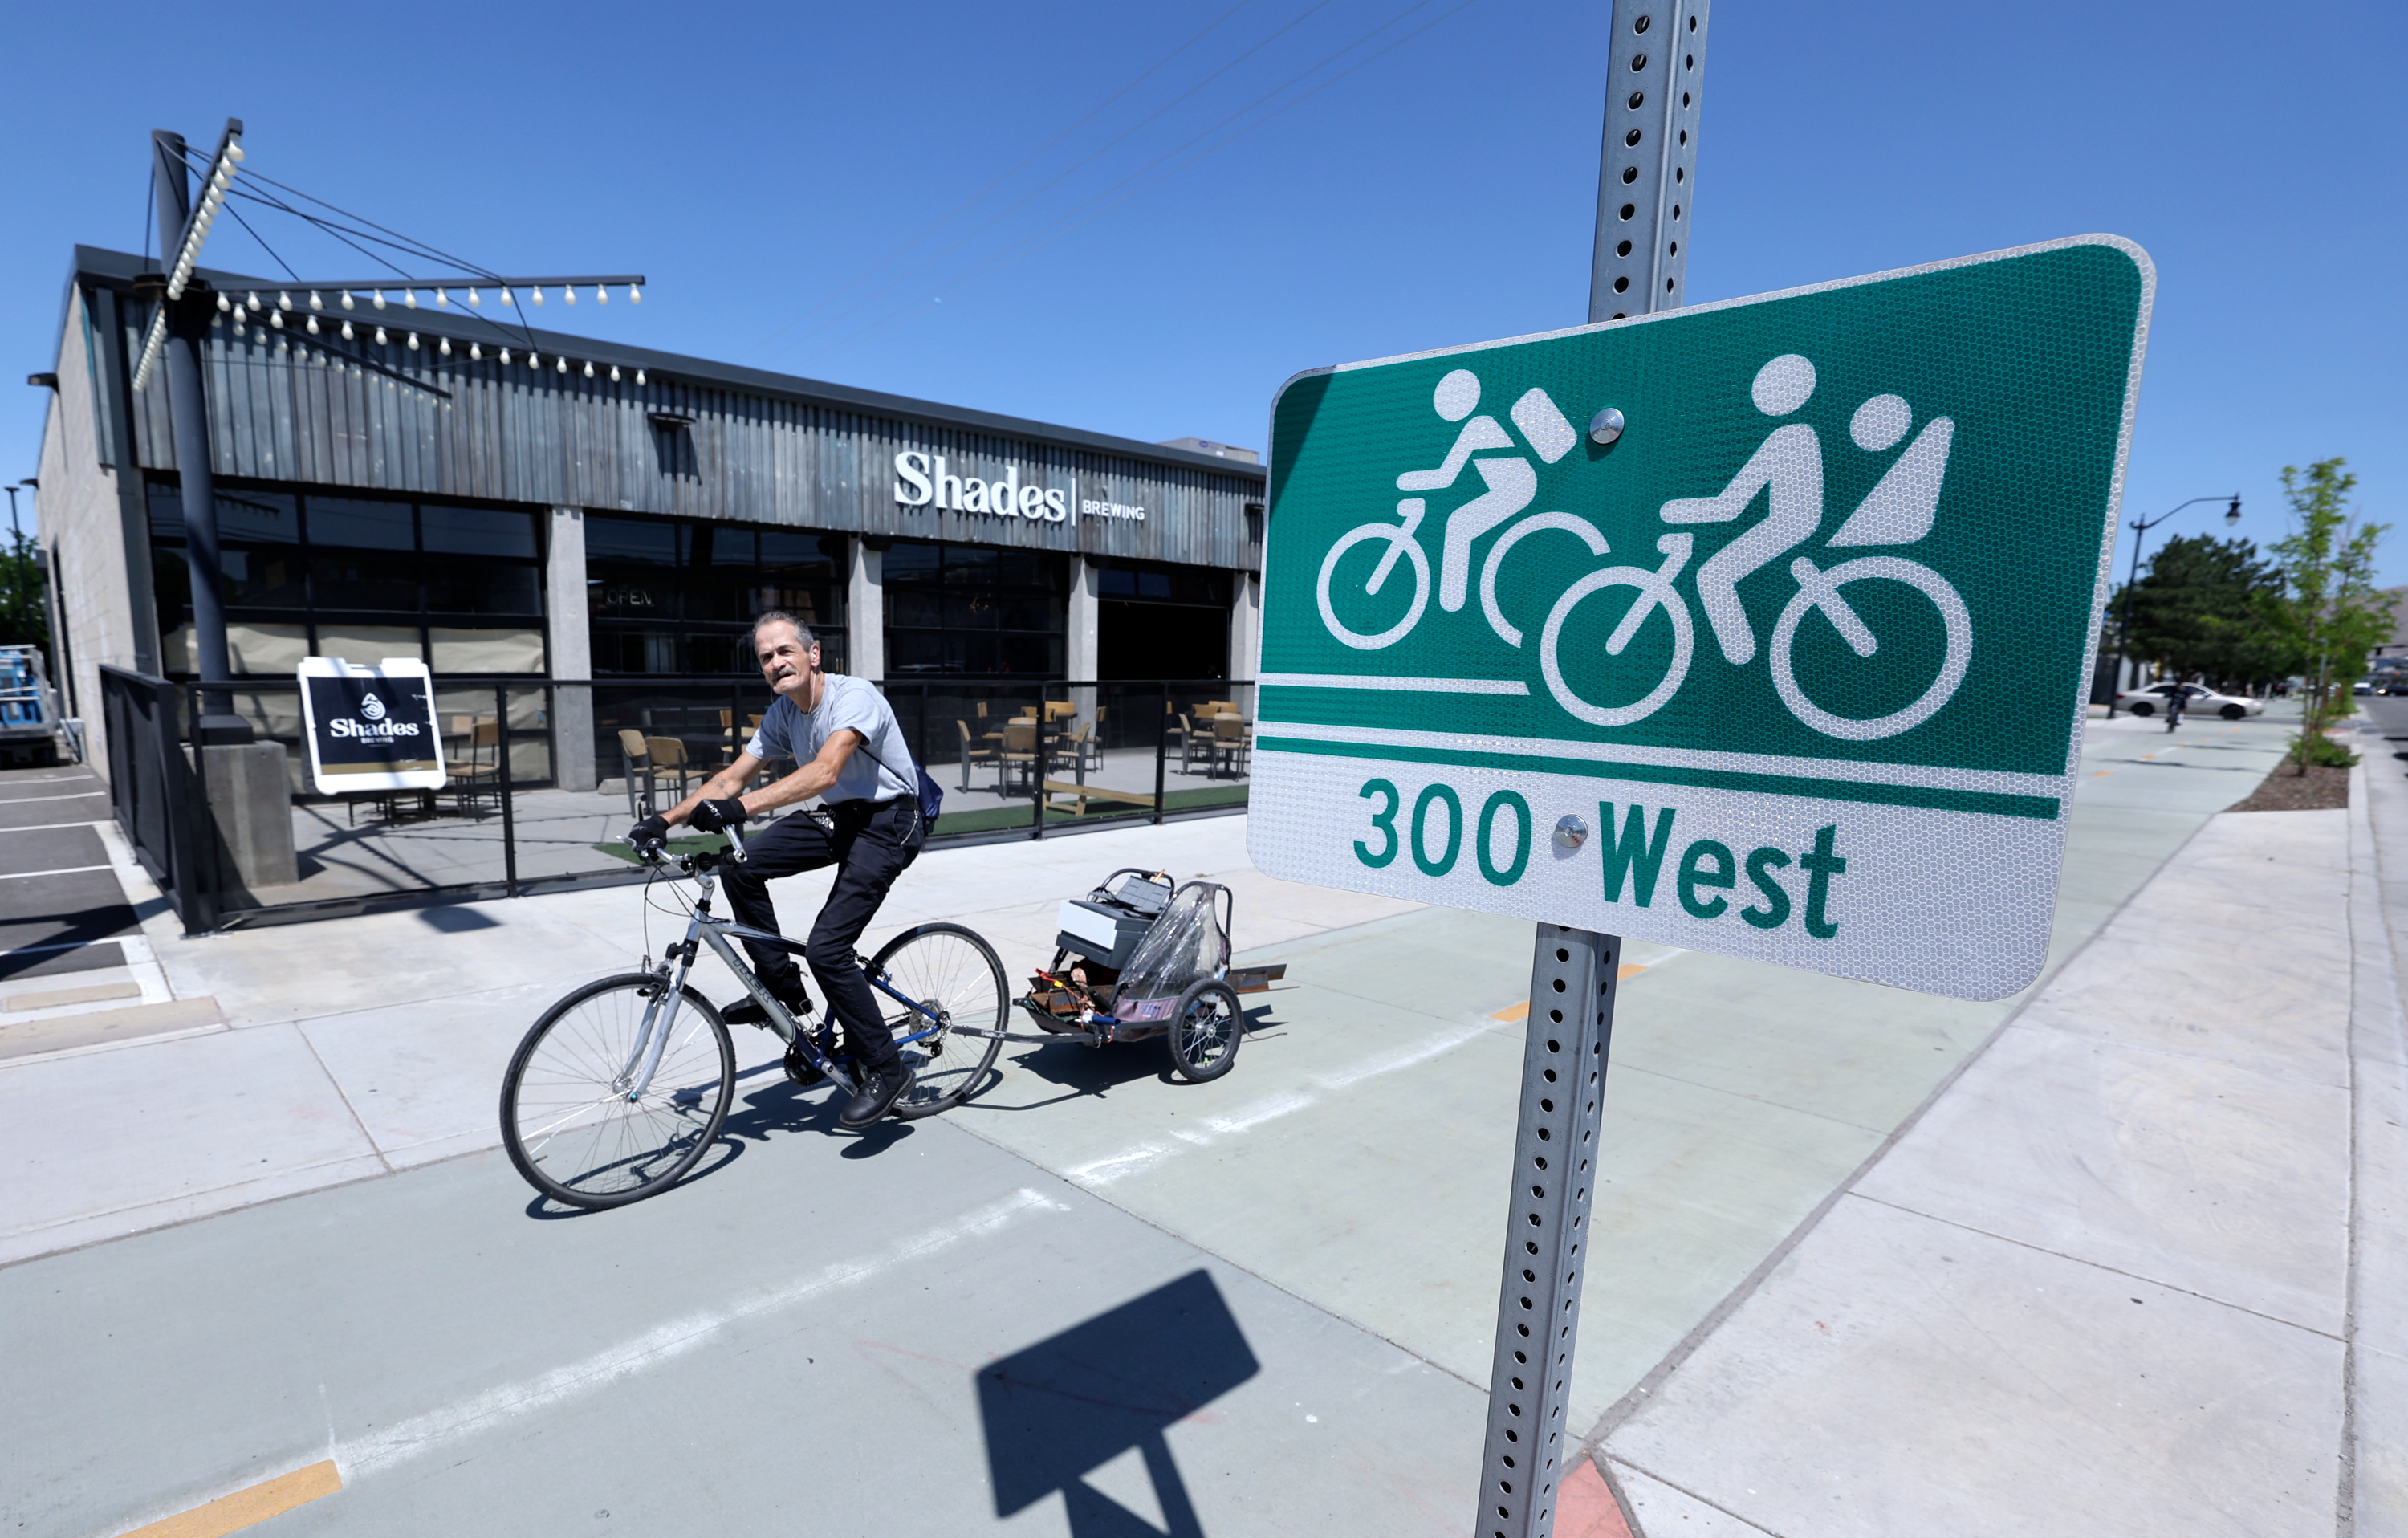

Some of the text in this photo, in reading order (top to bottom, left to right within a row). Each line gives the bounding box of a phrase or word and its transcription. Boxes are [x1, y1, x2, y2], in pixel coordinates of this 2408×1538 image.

[894, 450, 1145, 523] Shades BREWING
[607, 588, 652, 605] OPEN
[330, 718, 420, 738] Shades
[360, 736, 394, 744] BREWING
[1353, 778, 1846, 939] 300 West
[732, 954, 775, 1004] TREK
